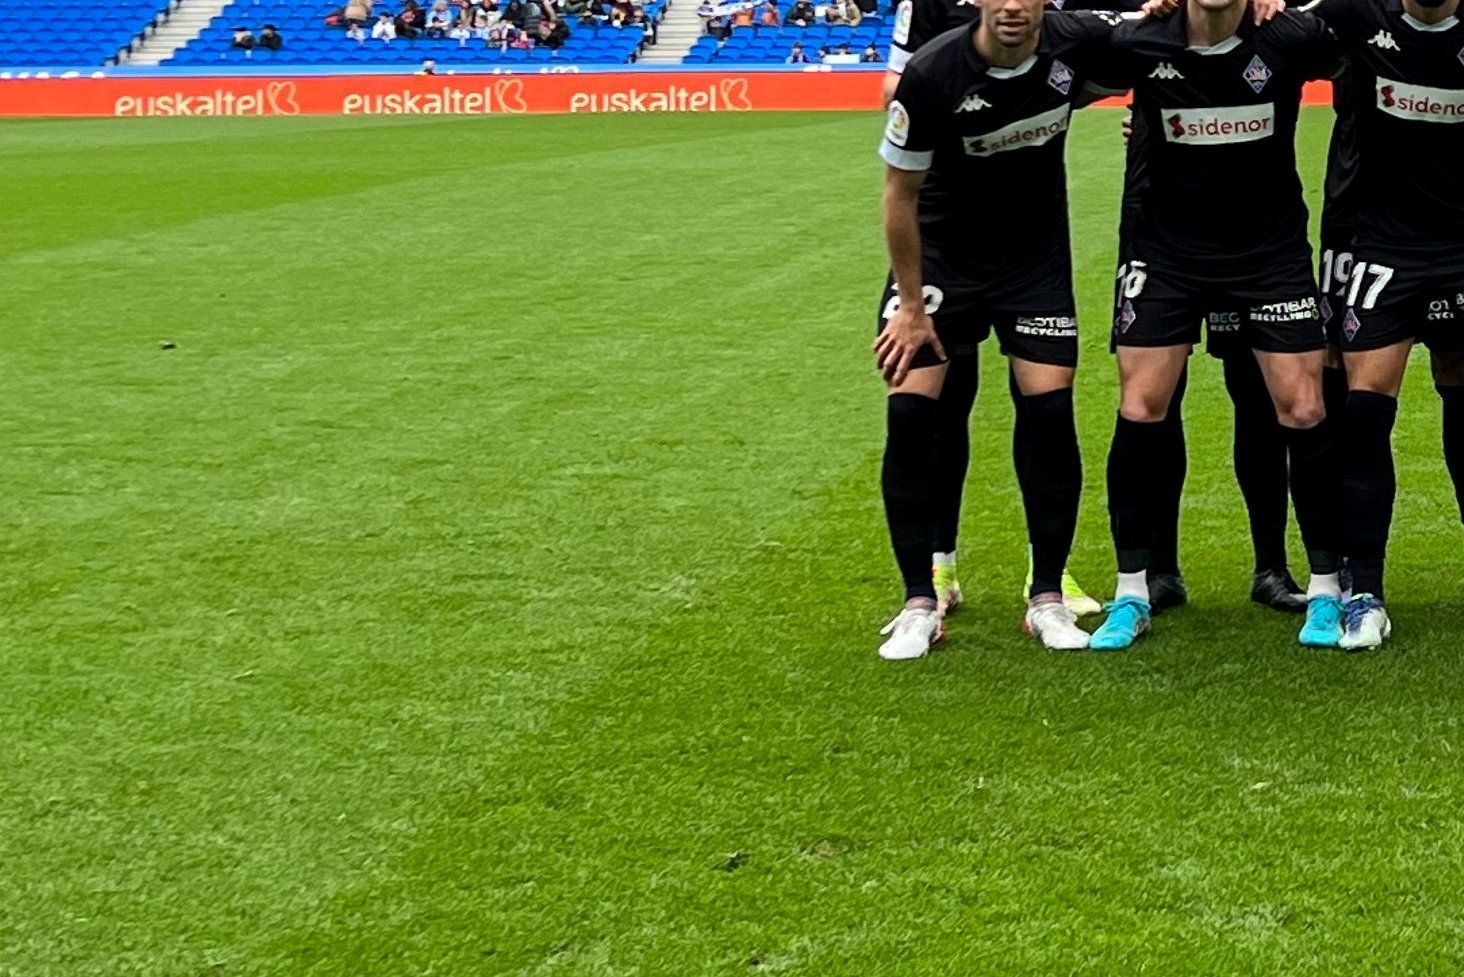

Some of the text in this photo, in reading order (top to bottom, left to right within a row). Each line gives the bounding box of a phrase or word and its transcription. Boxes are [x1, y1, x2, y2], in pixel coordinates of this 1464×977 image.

[114, 80, 264, 116] euskaltel
[342, 79, 491, 115] euskaltel
[569, 78, 718, 113] euskaltel
[1187, 113, 1272, 138] sidenor
[1346, 261, 1394, 309] 17
